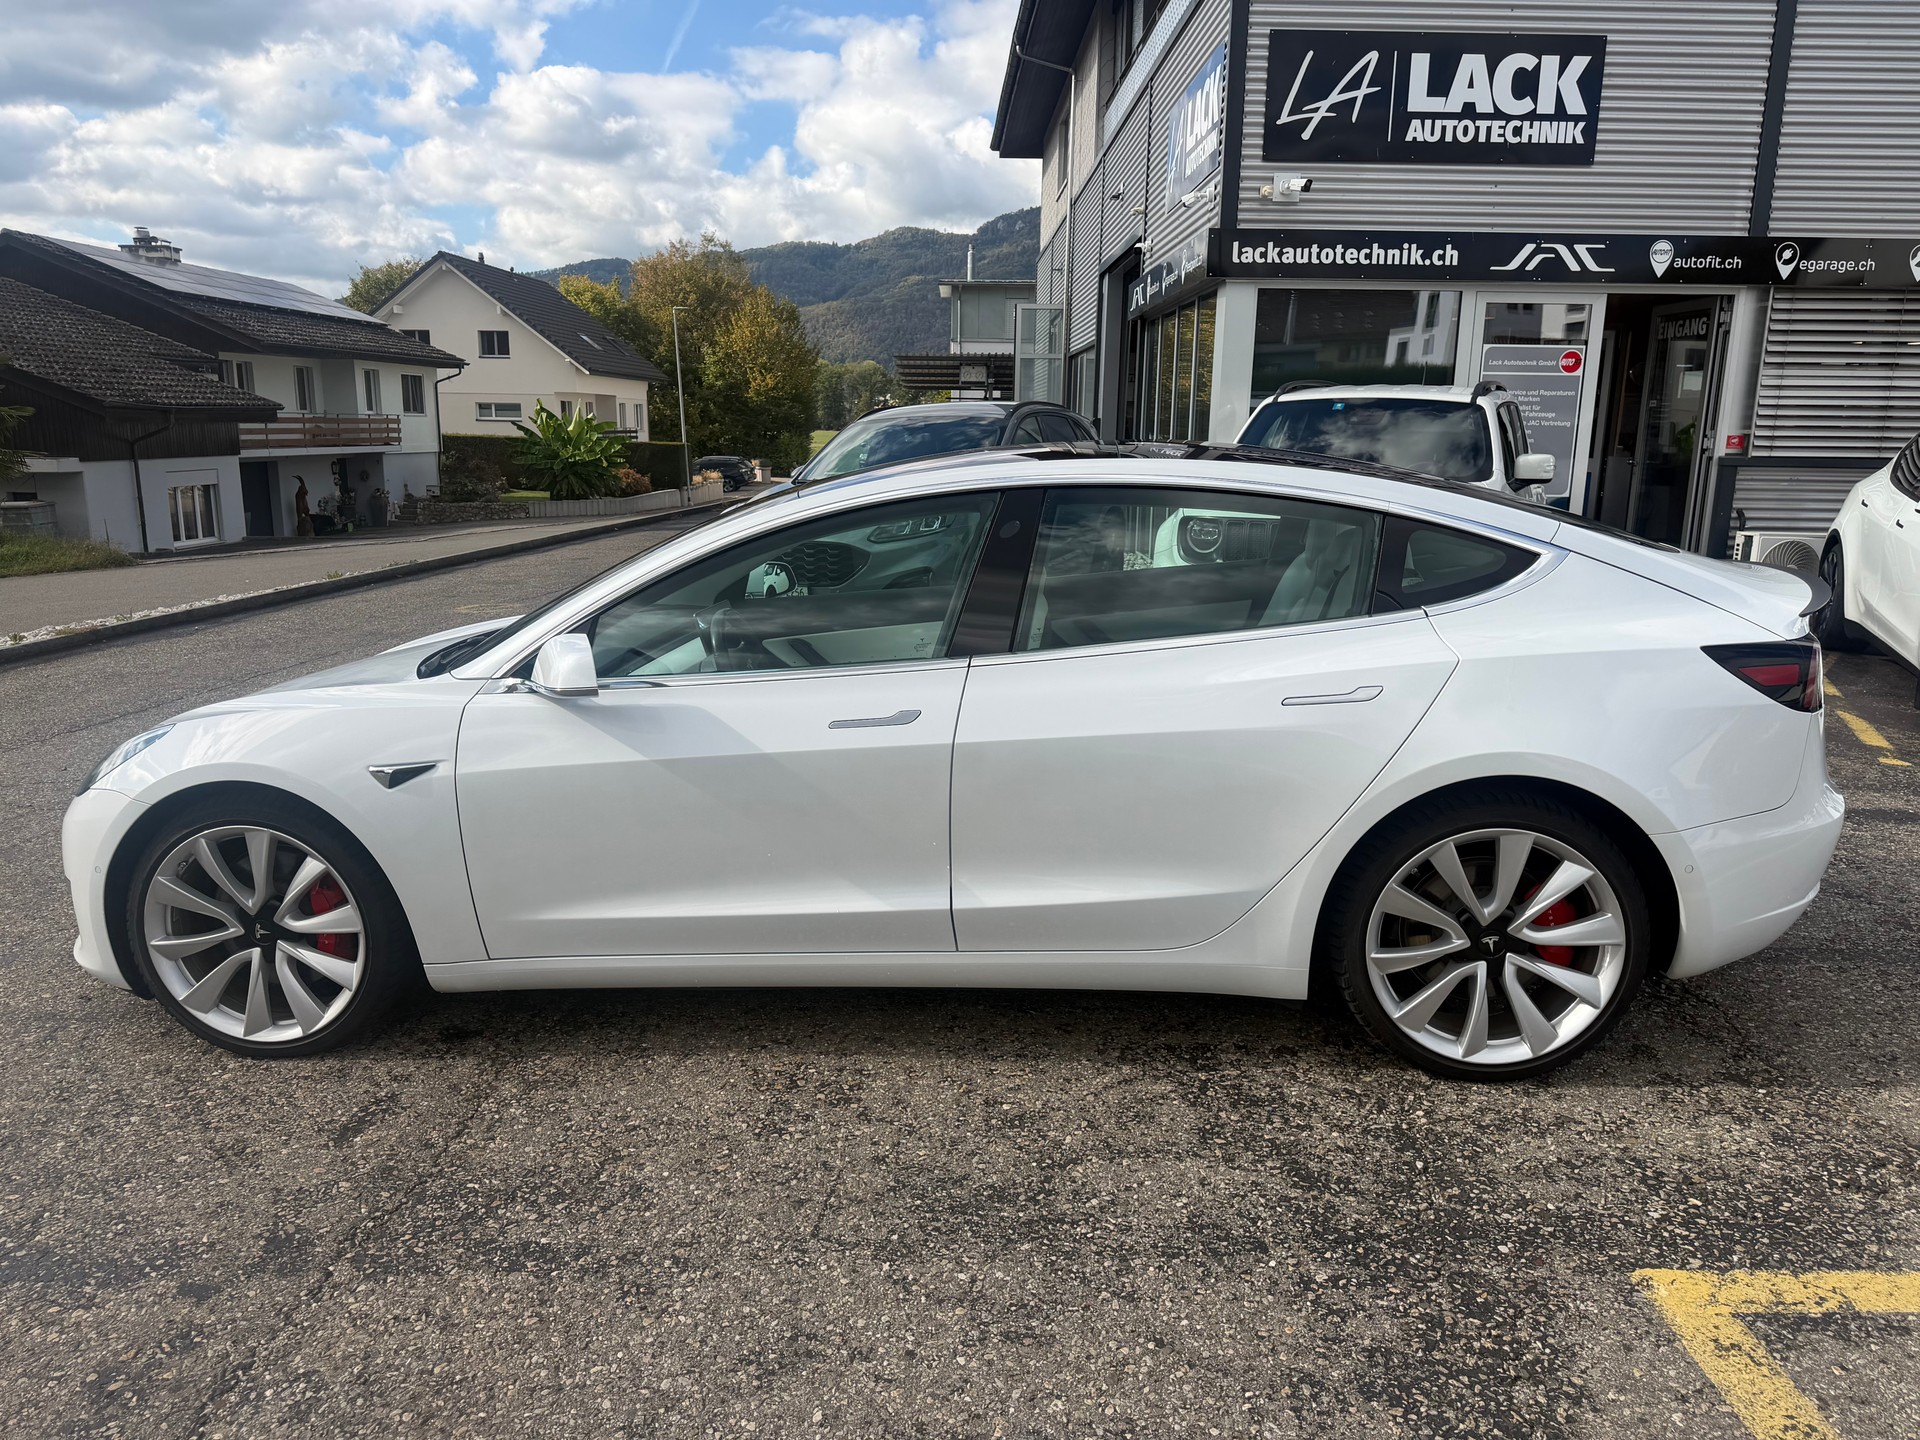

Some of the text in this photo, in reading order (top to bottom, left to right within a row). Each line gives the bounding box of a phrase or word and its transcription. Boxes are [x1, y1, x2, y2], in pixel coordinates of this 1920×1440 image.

[1407, 52, 1593, 116] LACK
[1185, 63, 1222, 154] LACK
[1404, 118, 1587, 144] AUTOTECHNIK
[1232, 241, 1459, 266] lackautotechnik.ch
[1673, 255, 1742, 269] autofit.ch
[1799, 258, 1876, 273] egarage.ch
[1657, 316, 1708, 340] EINGANG
[1539, 389, 1576, 397] Reparaturen
[1540, 420, 1571, 428] Vertretung
